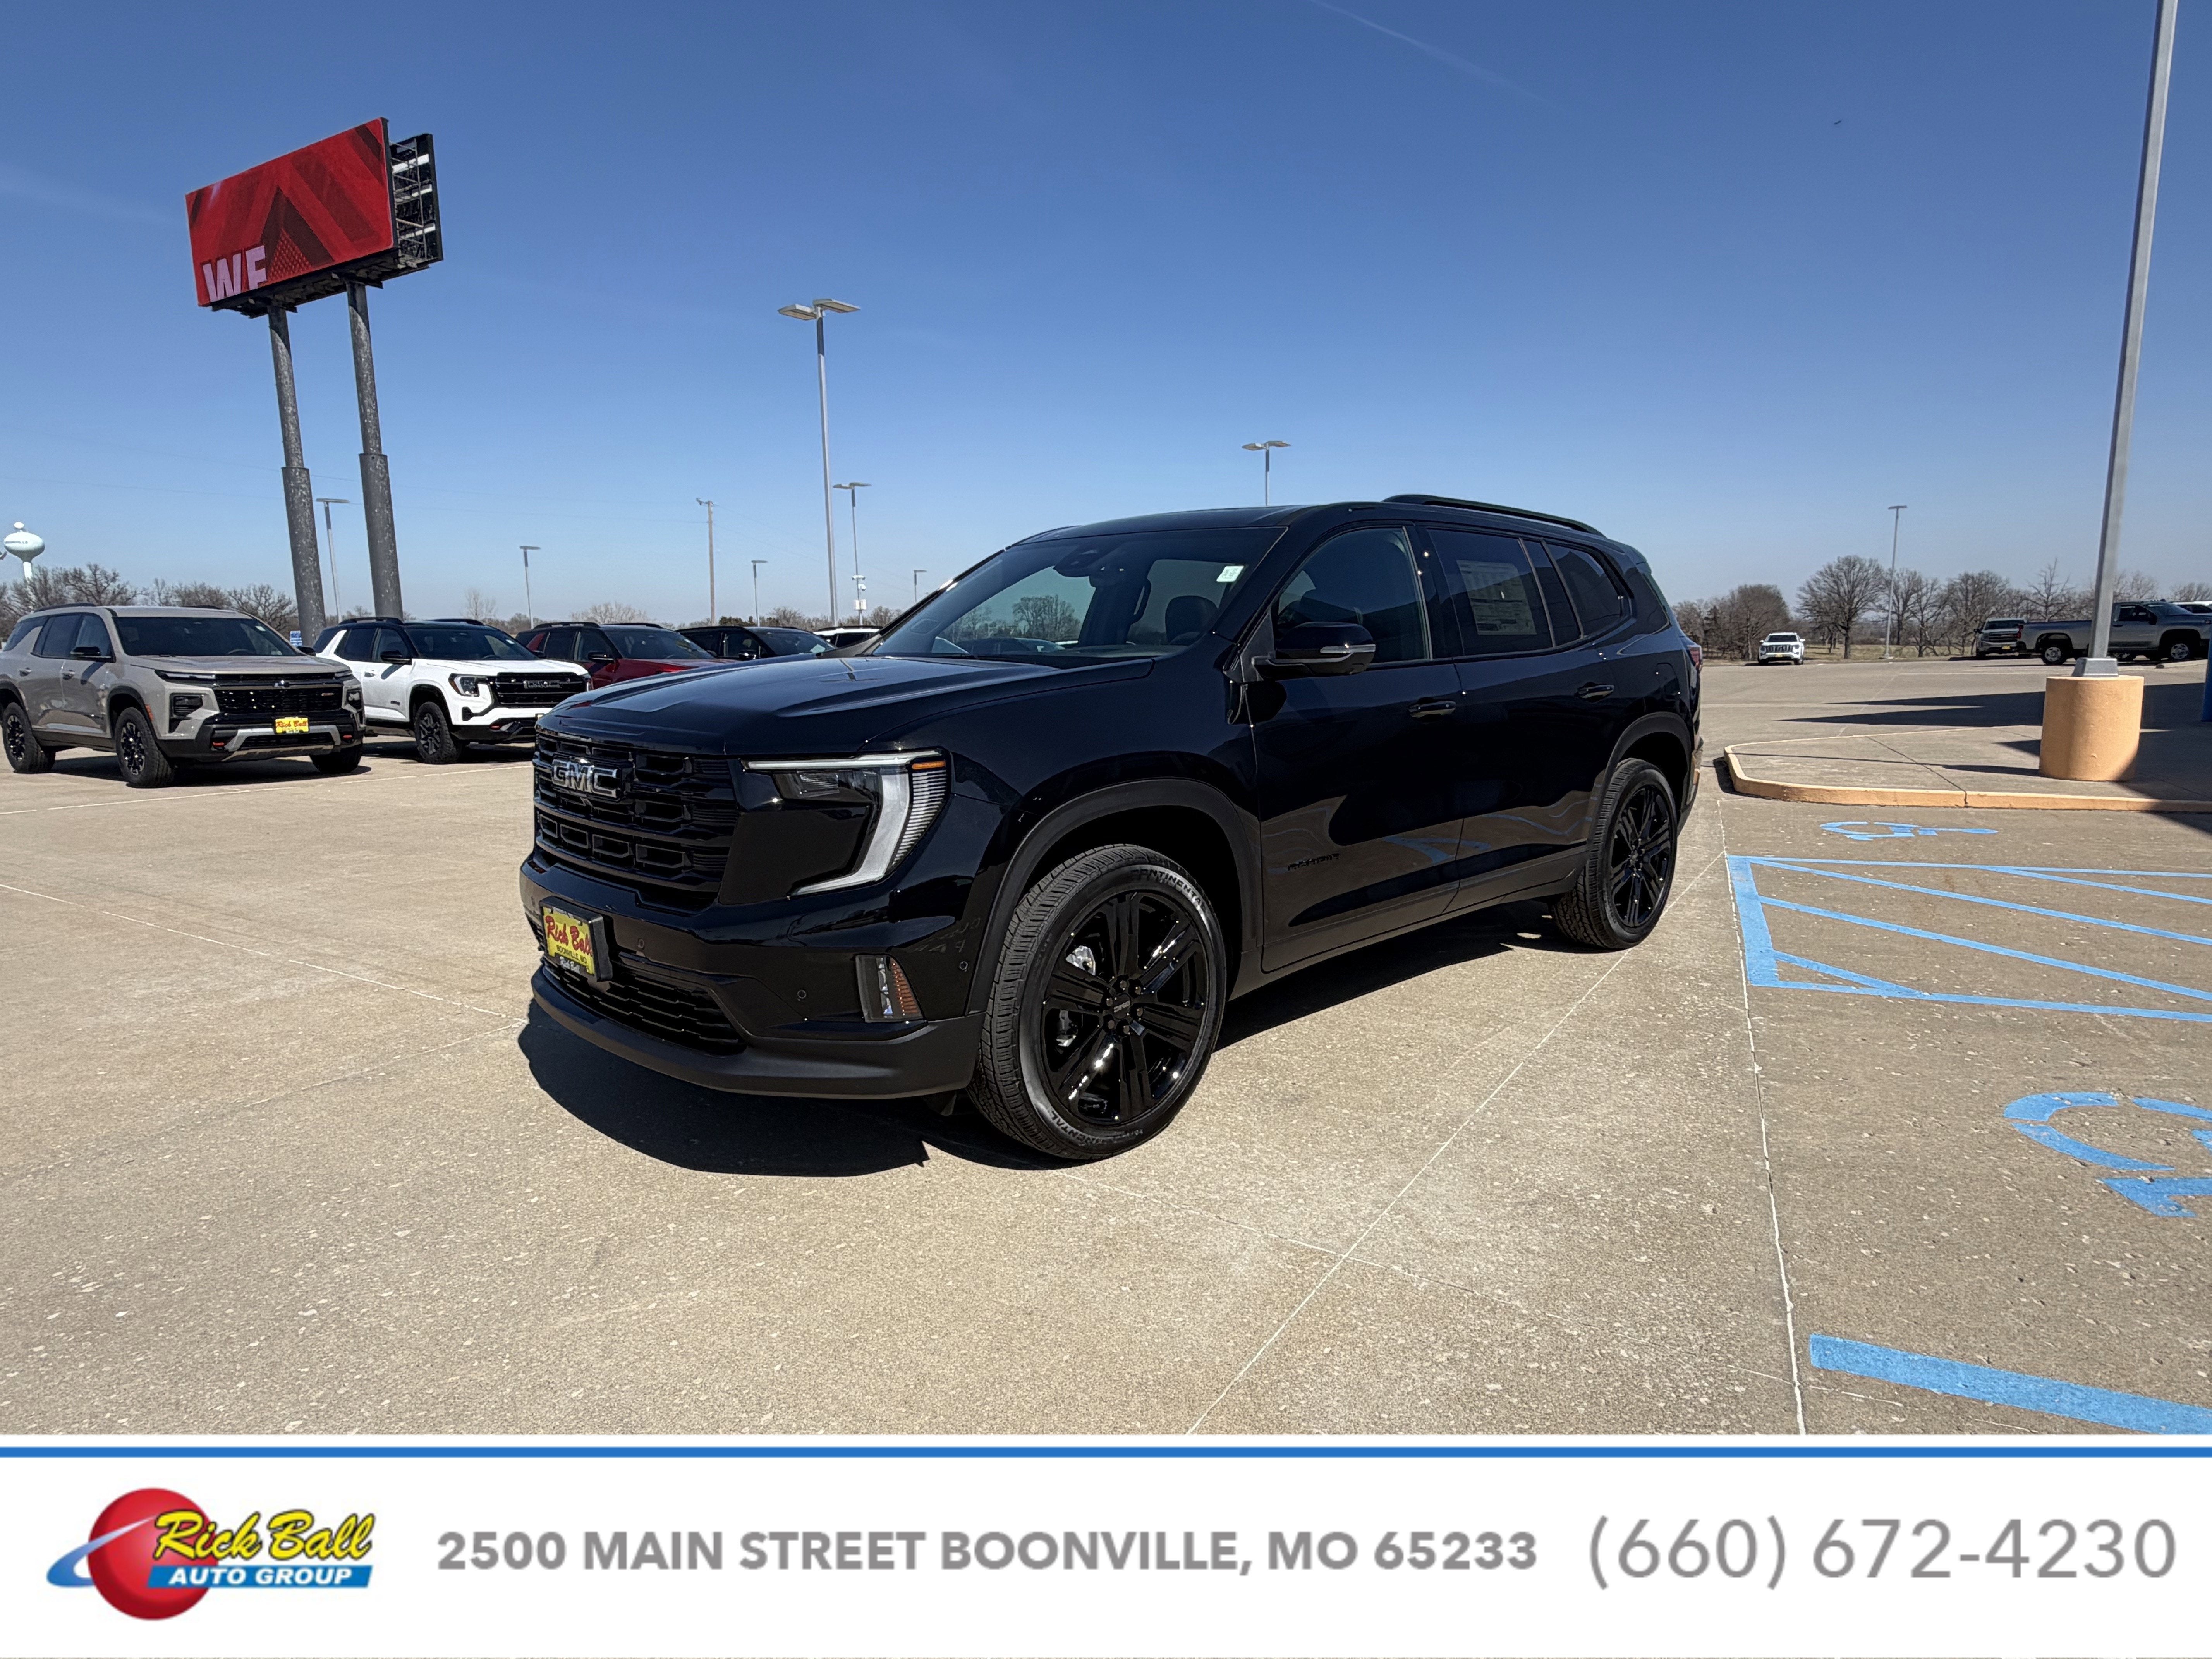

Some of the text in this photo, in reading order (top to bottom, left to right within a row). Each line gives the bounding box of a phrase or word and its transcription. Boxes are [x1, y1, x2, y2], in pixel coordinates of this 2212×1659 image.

[552, 759, 618, 799] GMC
[545, 915, 593, 957] Rick Ball
